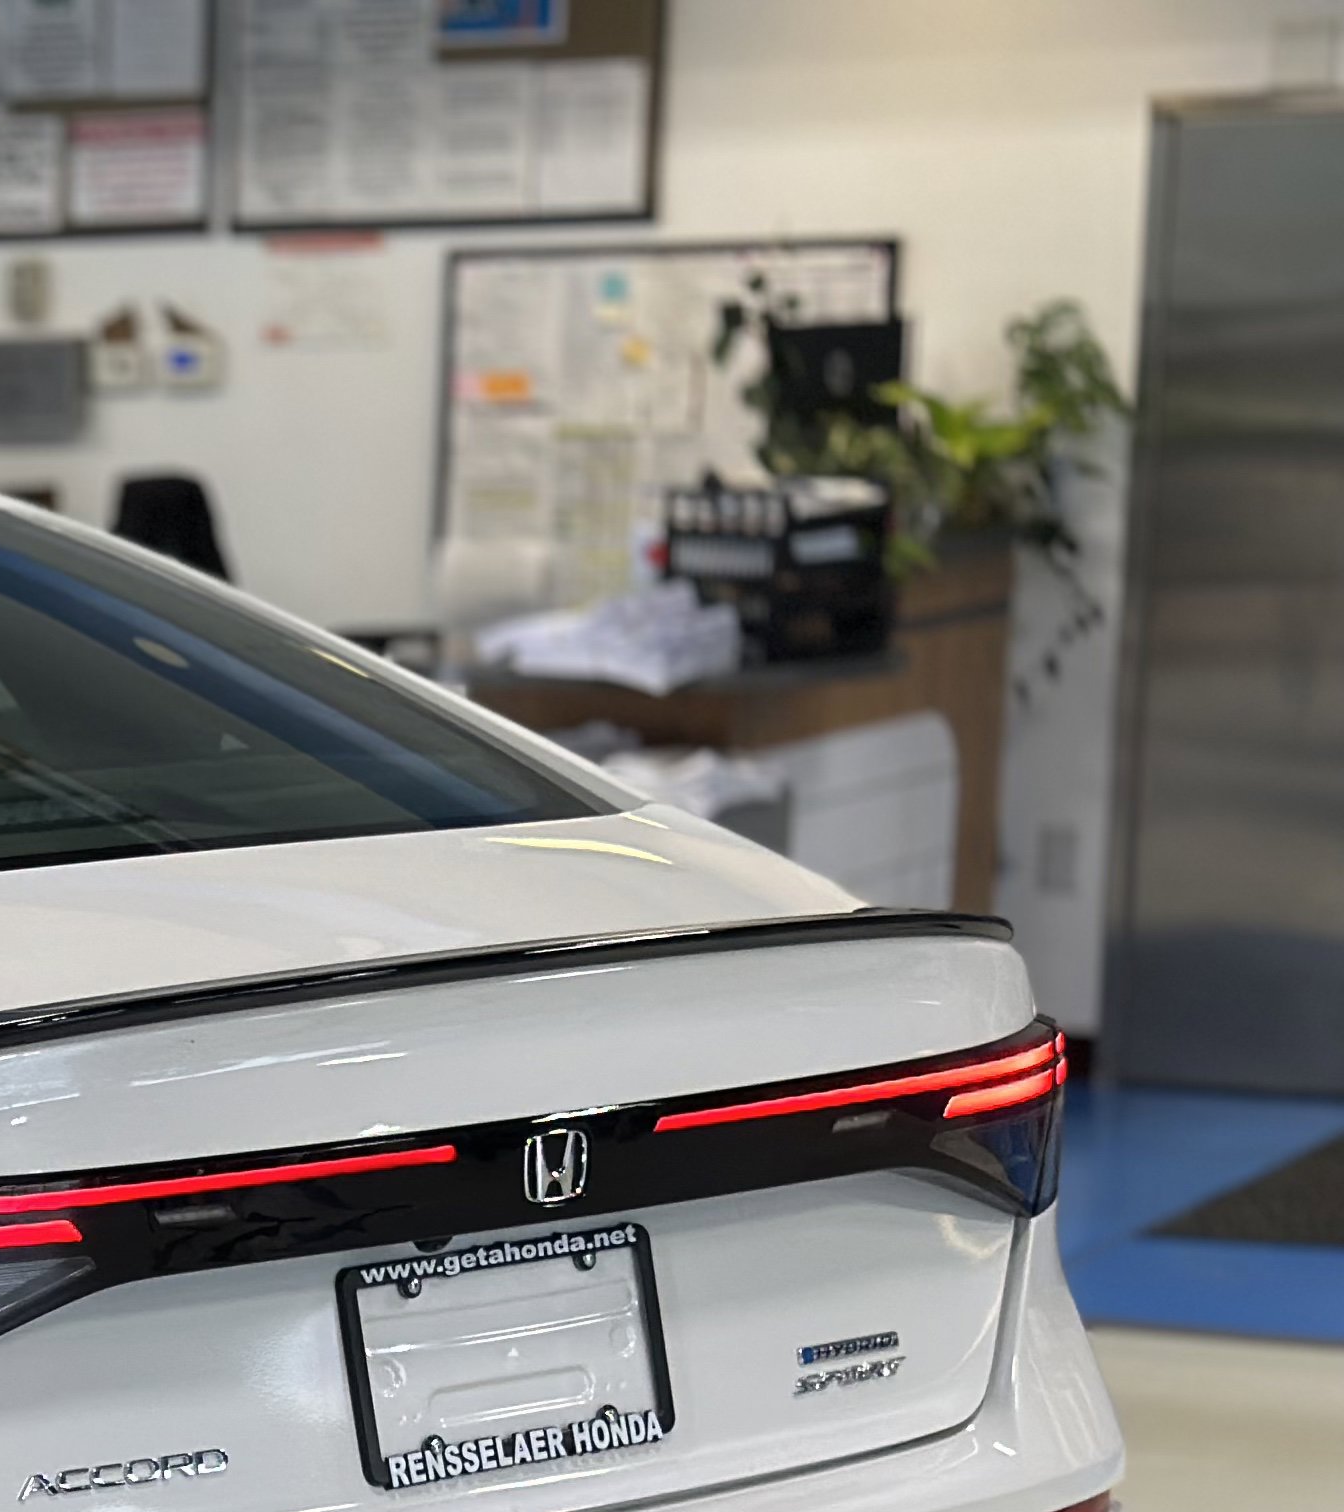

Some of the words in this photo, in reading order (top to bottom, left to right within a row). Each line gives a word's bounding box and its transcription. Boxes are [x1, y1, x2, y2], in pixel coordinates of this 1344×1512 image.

[360, 1223, 638, 1285] www.getahonda.net
[17, 1448, 229, 1502] ACCORD
[388, 1428, 567, 1489] RENSSELAER
[572, 1410, 665, 1455] HONDA
